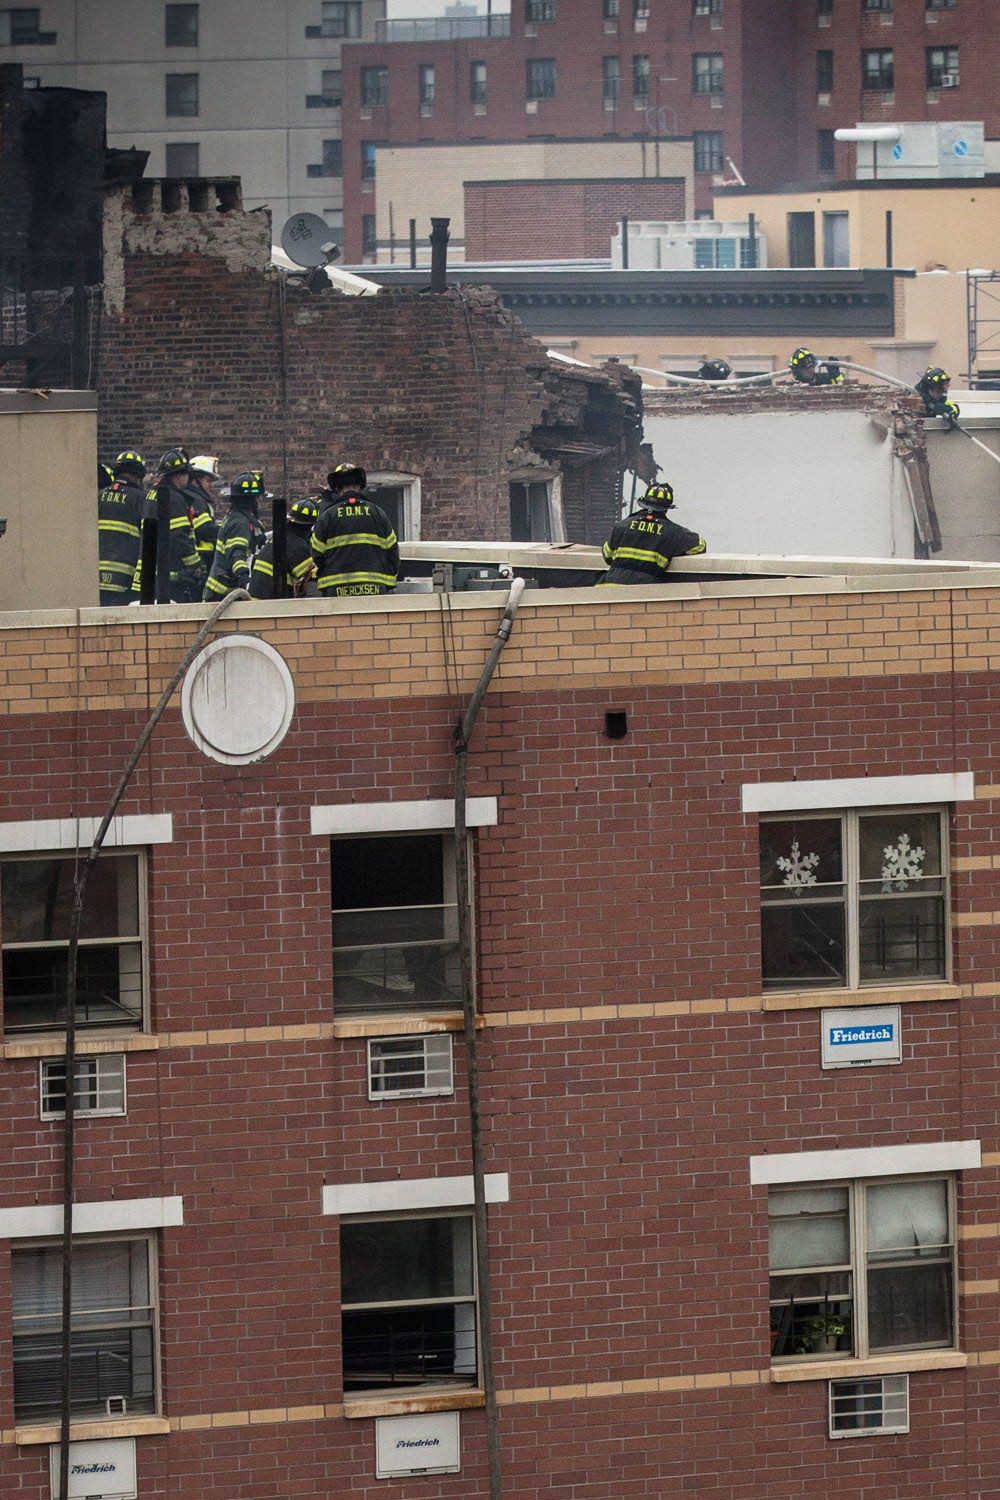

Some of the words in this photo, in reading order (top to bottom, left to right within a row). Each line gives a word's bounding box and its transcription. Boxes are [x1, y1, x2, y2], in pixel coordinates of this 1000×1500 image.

[336, 584, 380, 597] DIERCKSEN
[832, 1028, 891, 1043] Friedrich
[396, 1438, 440, 1448] Friedrich
[71, 1463, 116, 1474] Friedrich
